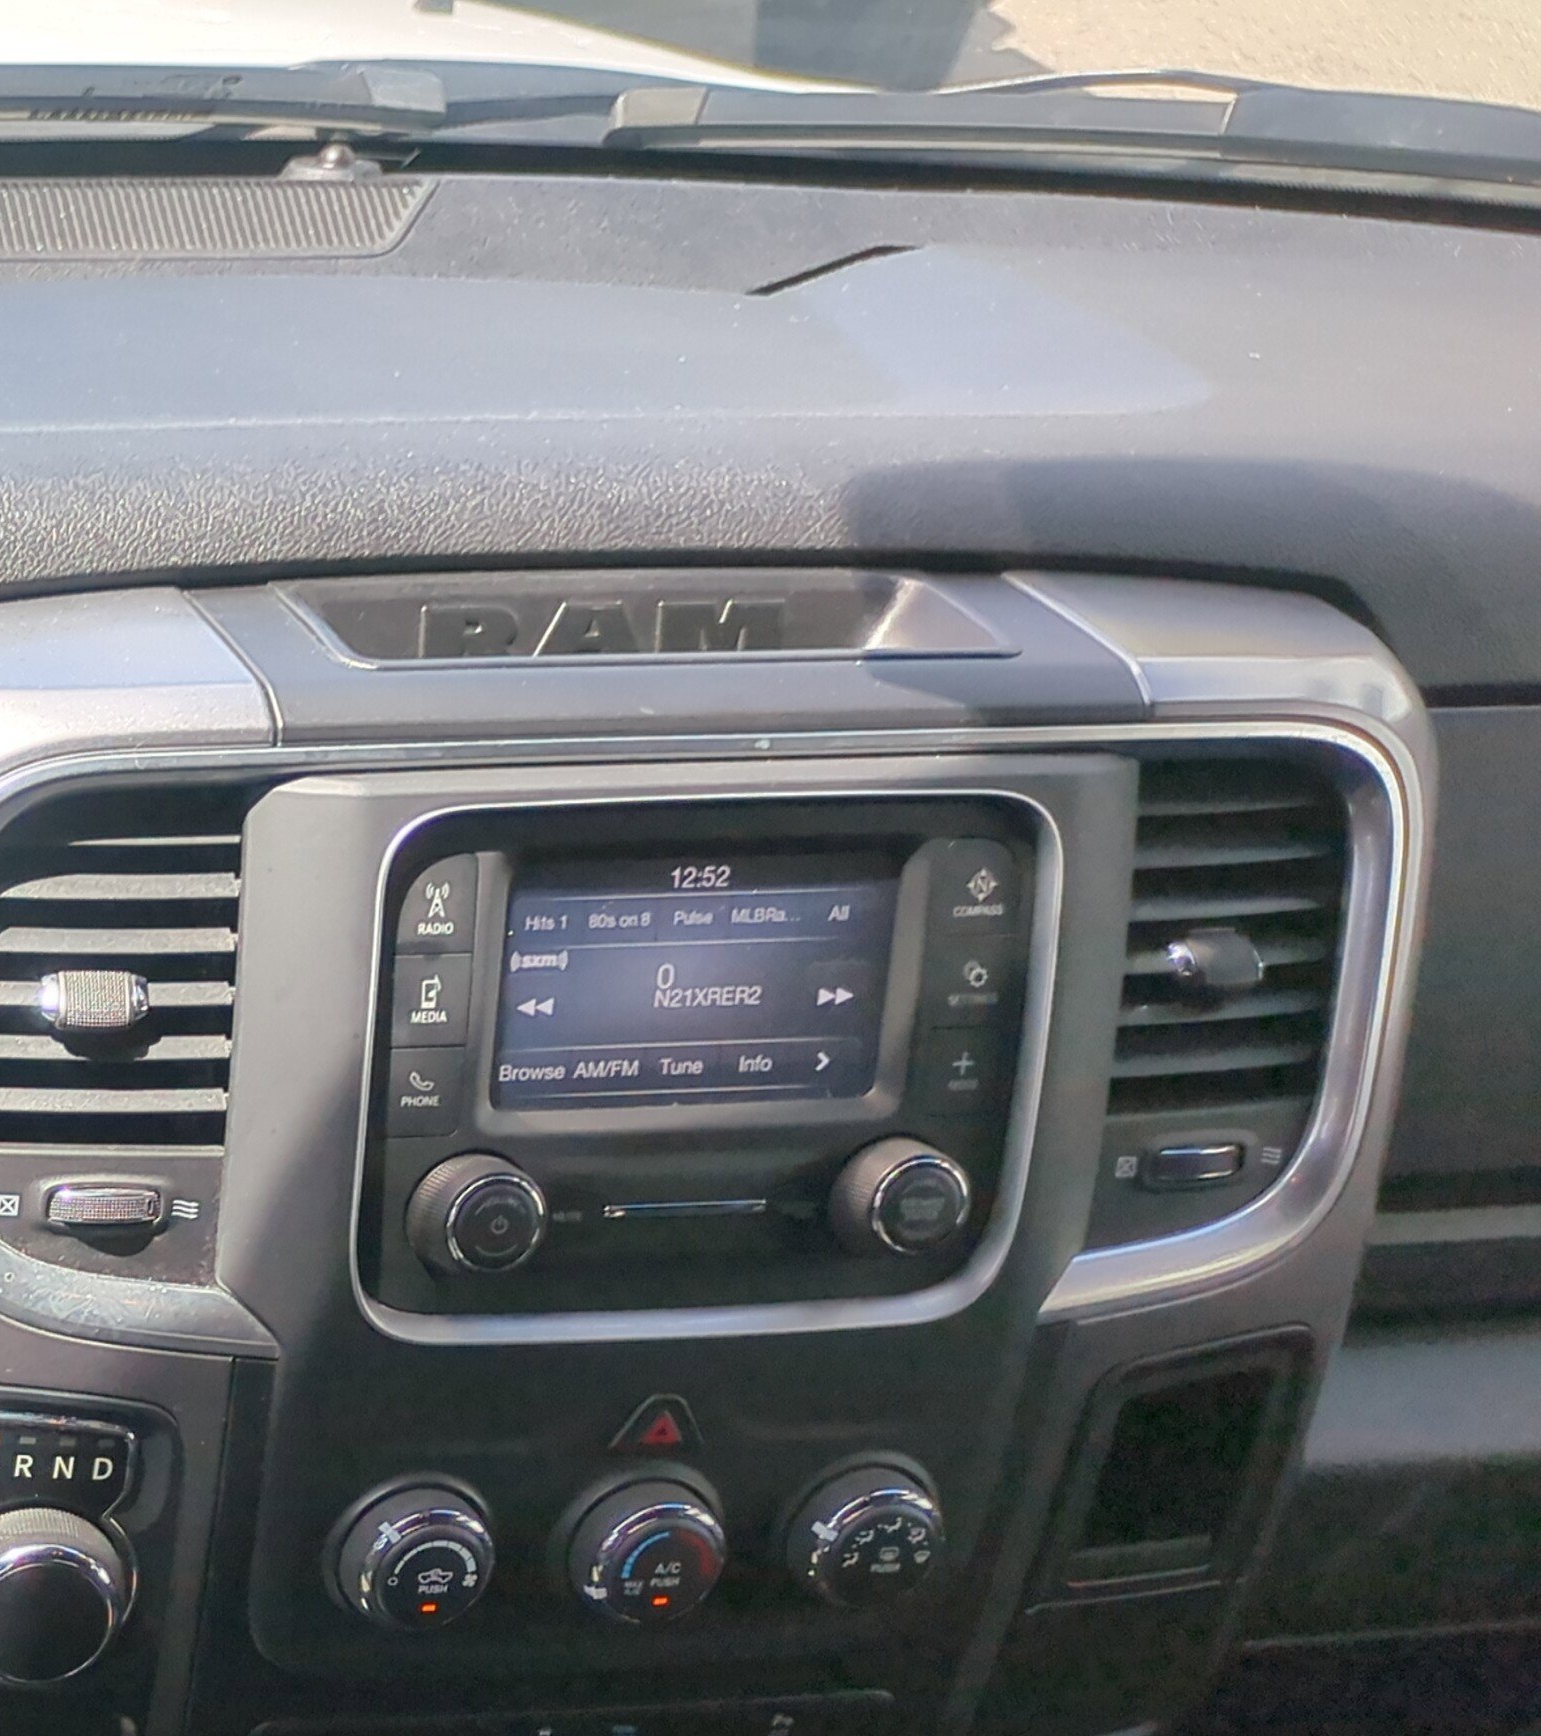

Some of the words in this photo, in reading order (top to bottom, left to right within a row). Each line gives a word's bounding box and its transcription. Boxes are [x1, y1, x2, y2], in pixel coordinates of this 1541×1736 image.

[418, 599, 786, 658] RAM
[670, 866, 731, 888] 12:52
[588, 913, 617, 928] 80s
[619, 916, 638, 928] on
[673, 910, 714, 925] Pulse
[828, 905, 850, 921] All
[417, 922, 454, 935] RADIO
[524, 915, 555, 930] Hits
[656, 963, 675, 989] 0
[410, 1011, 448, 1024] MEDIA
[573, 1059, 640, 1079] AM/FM
[660, 1058, 703, 1076] Tune
[738, 1054, 773, 1073] Info
[498, 1065, 565, 1081] Browse
[400, 1095, 440, 1107] PHONE
[13, 1455, 34, 1478] R
[51, 1456, 76, 1480] N
[91, 1456, 115, 1480] D
[654, 1561, 681, 1574] A/C
[418, 1584, 448, 1594] PUSH
